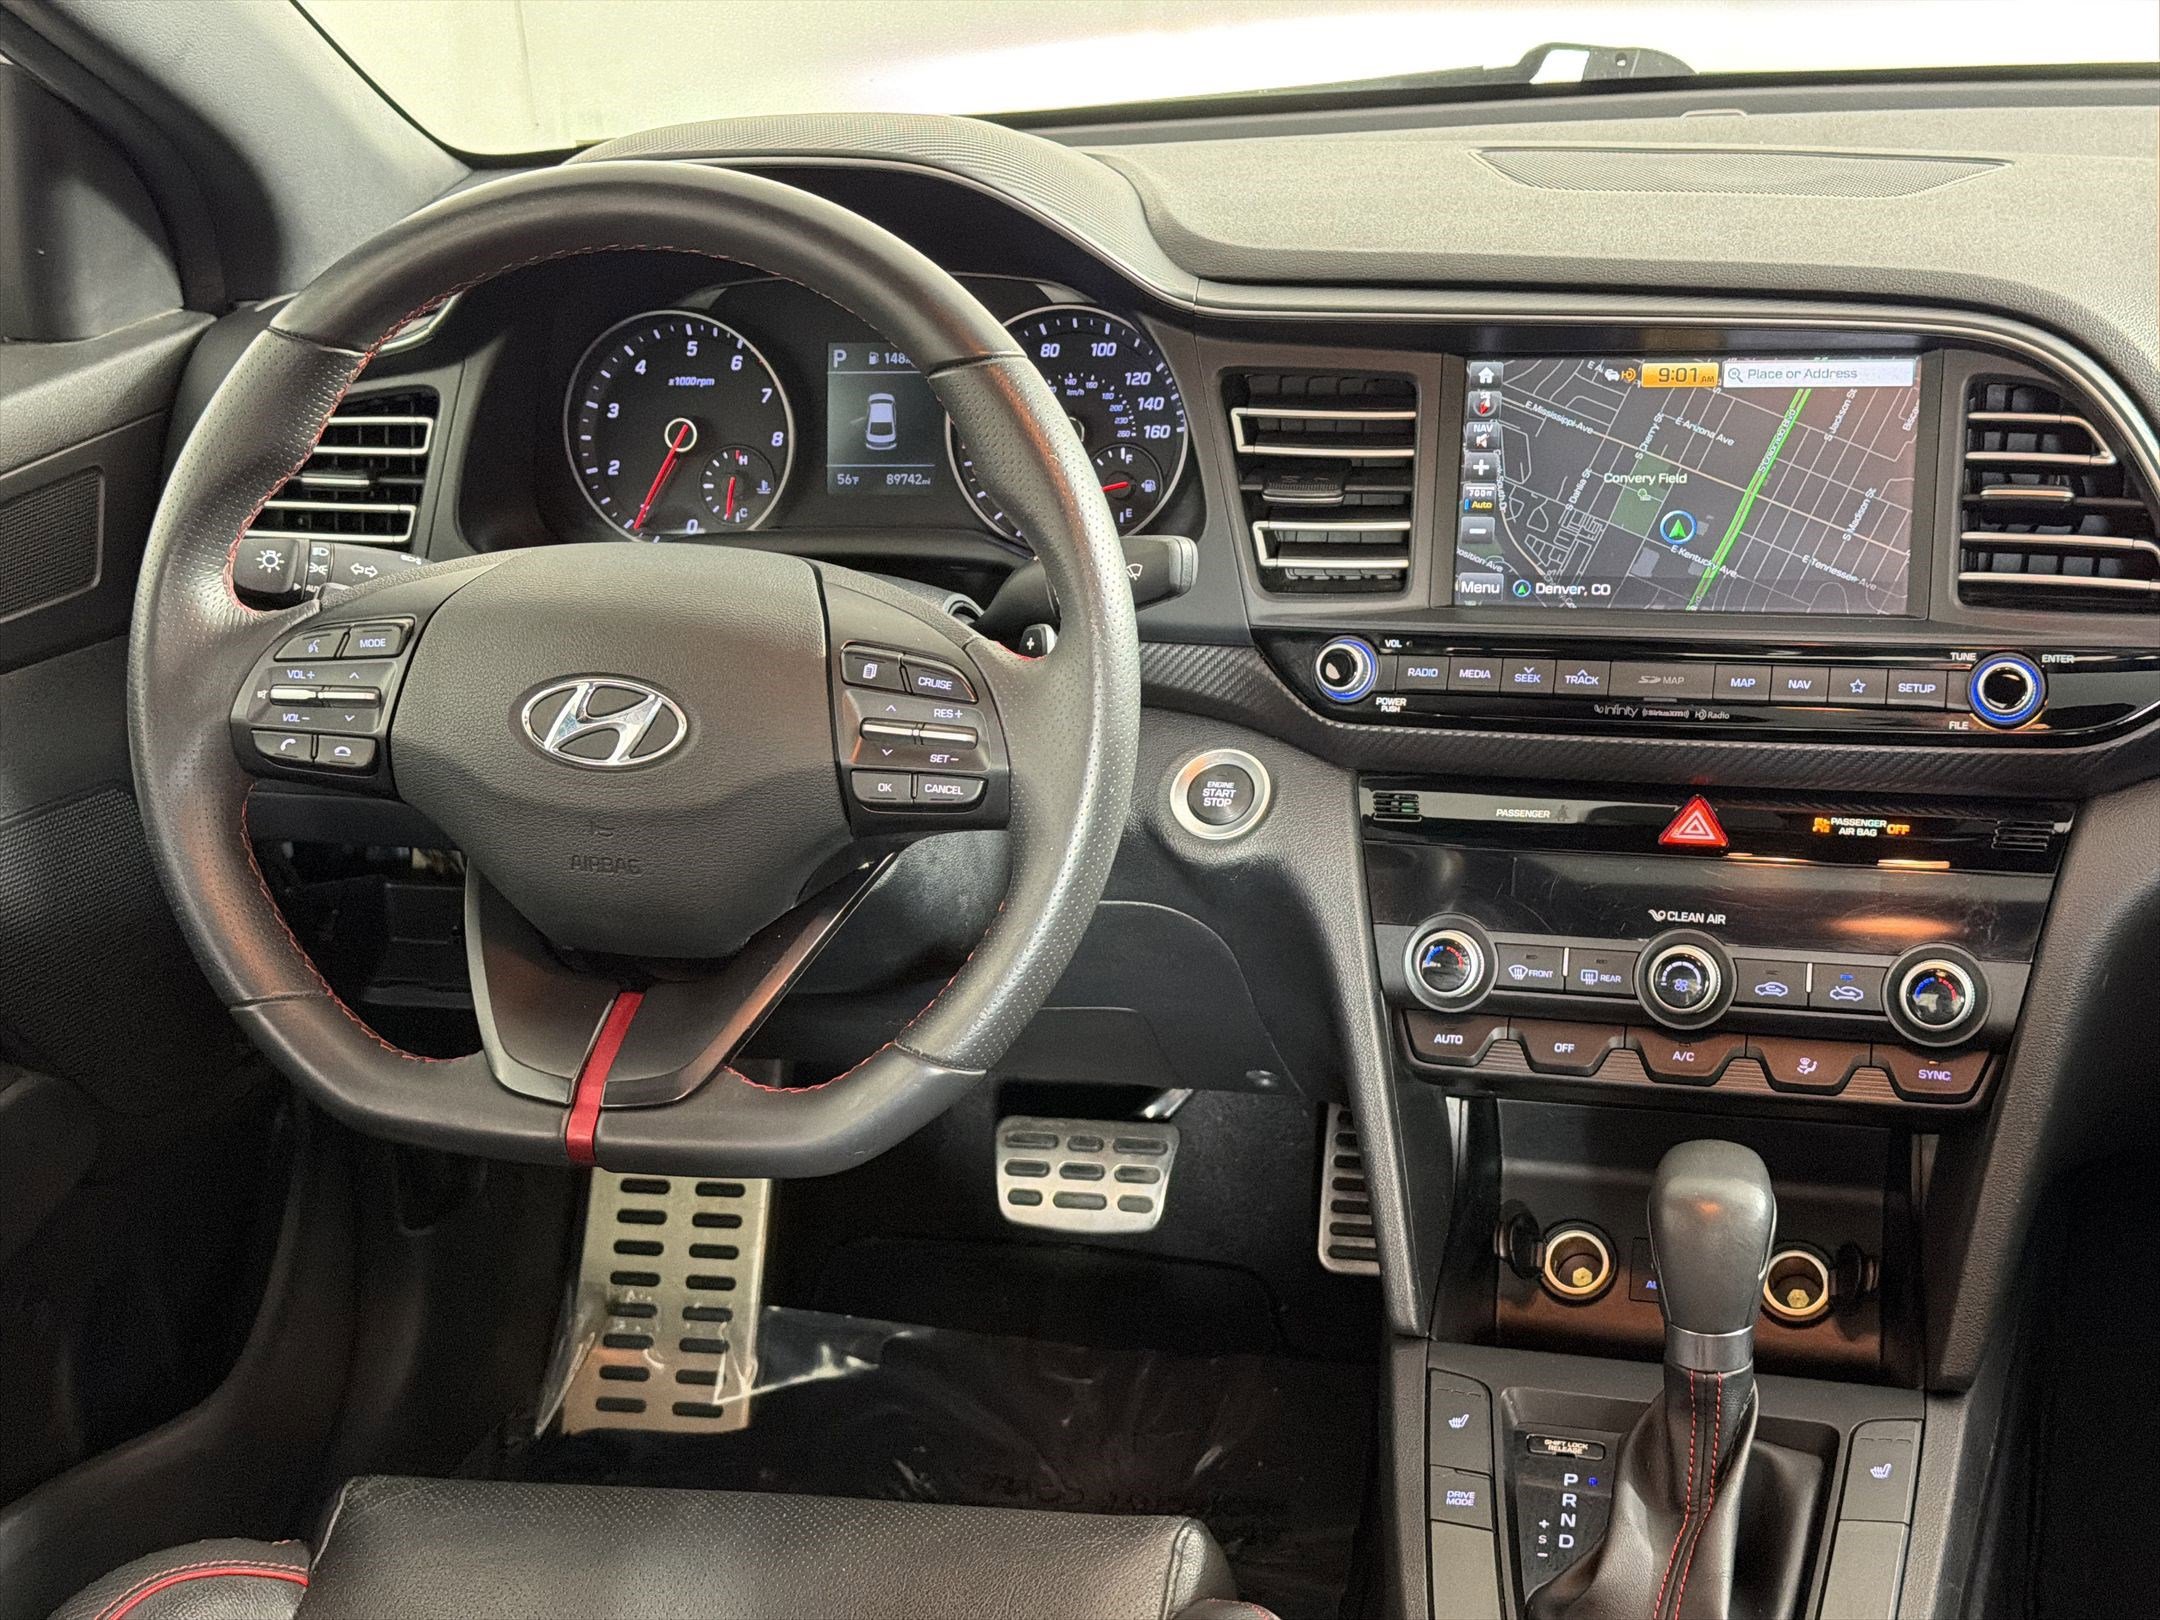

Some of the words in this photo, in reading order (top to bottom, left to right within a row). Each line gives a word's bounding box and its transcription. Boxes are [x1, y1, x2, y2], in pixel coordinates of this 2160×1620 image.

[687, 341, 698, 356] 5
[1040, 343, 1060, 358] 80
[1090, 342, 1116, 357] 100
[731, 355, 743, 370] 6
[834, 349, 846, 368] P
[635, 360, 646, 374] 4
[1125, 372, 1152, 386] 120
[1658, 368, 1698, 382] 9:01
[1748, 369, 1782, 380] Place
[1786, 370, 1800, 379] or
[1804, 368, 1858, 379] Address
[762, 388, 772, 402] 7
[1138, 396, 1164, 410] 140
[608, 403, 619, 418] 3
[1525, 400, 1532, 408] E
[1534, 405, 1576, 428] Mississippi
[1576, 422, 1593, 434] Ave
[1824, 434, 1833, 442] S
[1829, 400, 1852, 434] Jackson
[1144, 425, 1170, 439] 160
[1474, 424, 1493, 432] NAV
[1682, 420, 1716, 439] Arizona
[1716, 434, 1734, 446] Ave
[772, 432, 783, 446] 8
[1634, 452, 1644, 460] S
[1639, 422, 1659, 452] Cherry
[738, 456, 748, 465] H
[1126, 454, 1132, 464] F
[608, 460, 620, 475] 2
[1604, 472, 1656, 486] Convery
[1659, 473, 1688, 484] Field
[1568, 479, 1587, 504] Dahlia
[1472, 500, 1492, 508] Auto
[1126, 508, 1132, 518] E
[1846, 498, 1870, 534] Madison
[687, 519, 698, 534] 0
[1842, 533, 1852, 541] S
[1486, 561, 1504, 572] Ave
[1671, 544, 1678, 553] E
[1678, 548, 1717, 570] Kentucky
[1720, 565, 1736, 578] Ave
[1811, 558, 1859, 582] Tennessee
[1858, 578, 1876, 590] Ave
[1461, 581, 1500, 594] Menu
[1536, 582, 1588, 596] Denver,
[1591, 584, 1611, 596] CO
[360, 638, 386, 648] MODE
[1385, 639, 1402, 648] VOL
[1950, 653, 1976, 662] TUNE
[2042, 655, 2074, 664] ENTER
[1408, 668, 1438, 678] RADIO
[1459, 669, 1490, 679] MEDIA
[918, 676, 952, 690] CRUISE
[1514, 674, 1540, 684] SEEK
[1565, 675, 1599, 685] TRACK
[1663, 676, 1684, 684] MAP
[1730, 678, 1756, 688] MAP
[1788, 680, 1812, 690] NAV
[1898, 684, 1936, 693] SETUP
[1376, 697, 1406, 706] POWER
[1708, 710, 1729, 720] Radio
[1949, 721, 1968, 730] FILE
[878, 783, 892, 792] OK
[924, 784, 964, 795] CANCEL
[1202, 788, 1236, 798] START
[1204, 798, 1232, 807] STOP
[1496, 808, 1550, 818] PASSENGER
[1831, 818, 1887, 828] PASSENGER
[1838, 828, 1855, 836] AIR
[1857, 828, 1878, 836] BAG
[1886, 824, 1910, 834] OFF
[570, 854, 642, 876] AIRBAG
[1667, 911, 1704, 923] CLEAN
[1706, 914, 1726, 925] AIR
[1528, 970, 1553, 978] FRONT
[1600, 974, 1622, 983] REAR
[1434, 1034, 1462, 1044] AUTO
[1554, 1043, 1574, 1053] OFF
[1672, 1051, 1694, 1062] A/C
[1918, 1070, 1952, 1081] SYNC
[1568, 1442, 1588, 1450] LOCK
[1564, 1474, 1578, 1486] P
[1447, 1490, 1475, 1499] DRIVE
[1446, 1498, 1474, 1506] MODE
[1562, 1494, 1576, 1508] R
[1561, 1514, 1576, 1527] N
[1538, 1534, 1547, 1544] S
[1558, 1534, 1574, 1548] D
